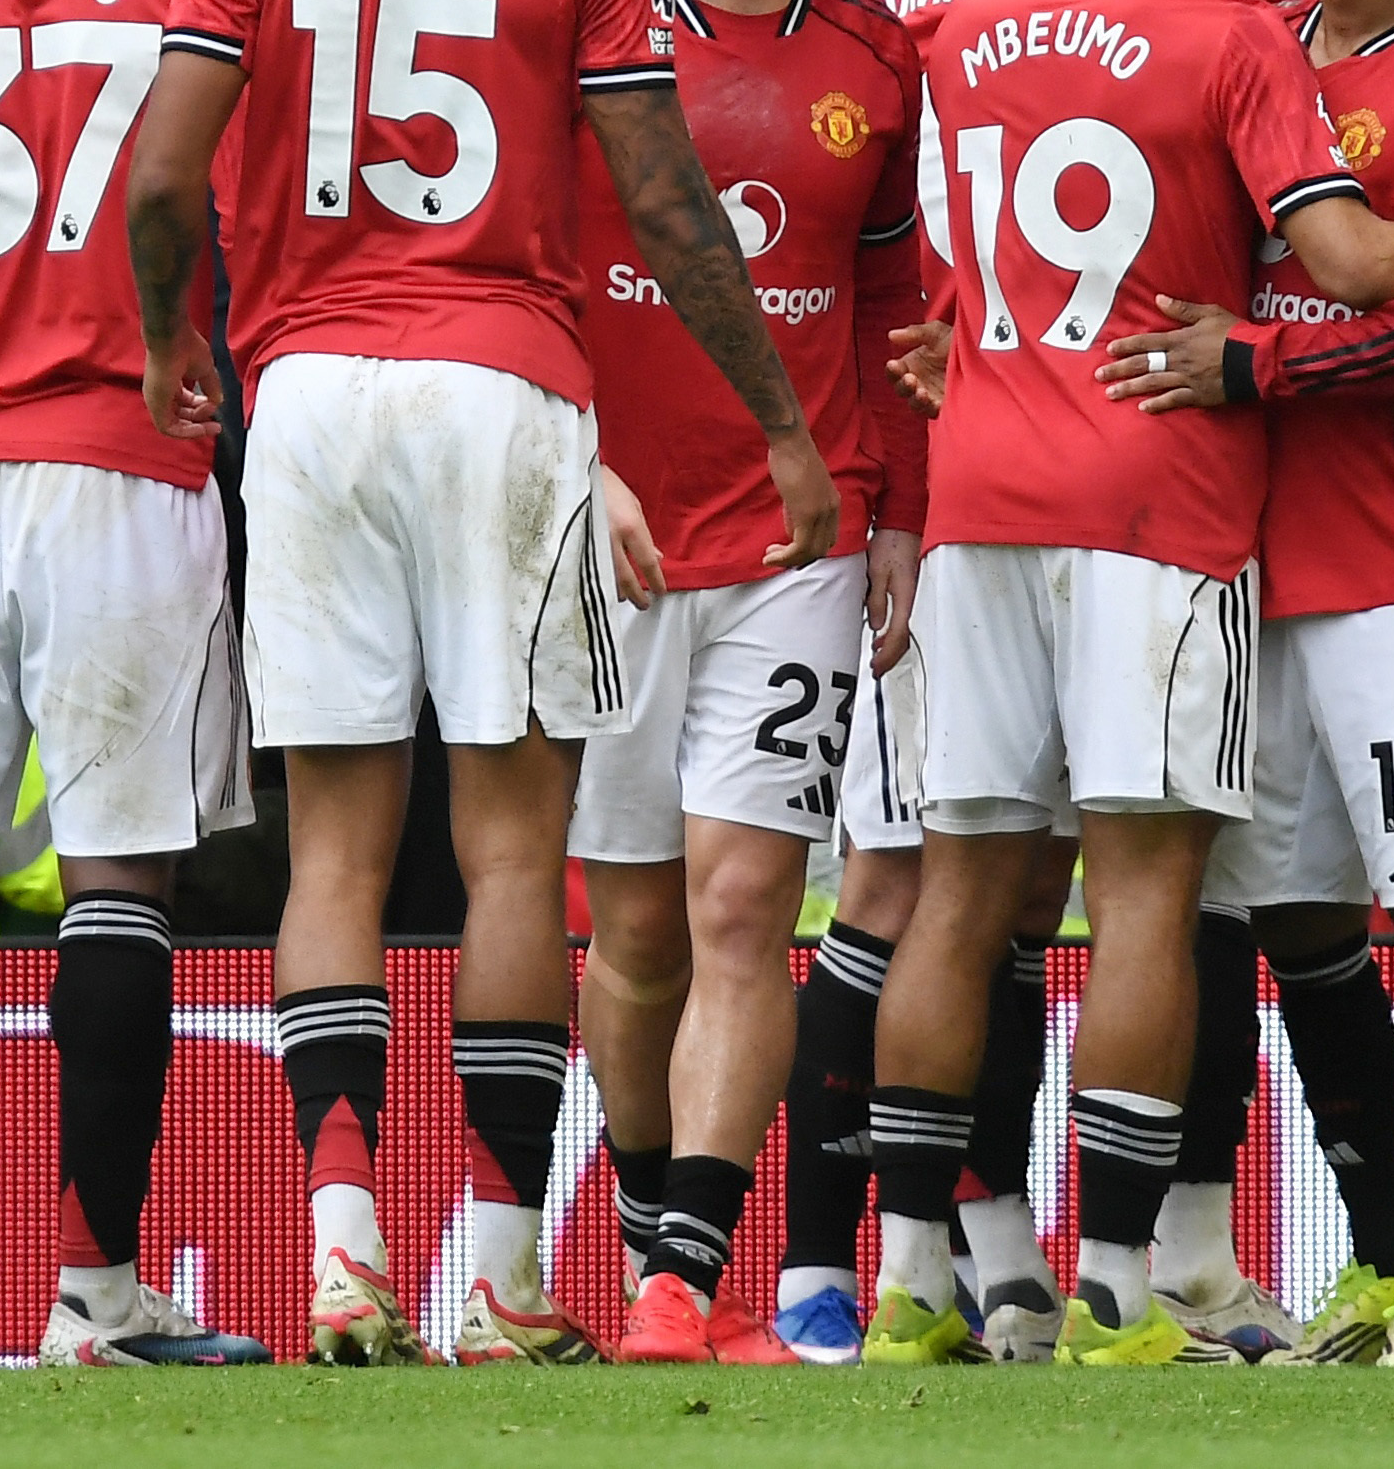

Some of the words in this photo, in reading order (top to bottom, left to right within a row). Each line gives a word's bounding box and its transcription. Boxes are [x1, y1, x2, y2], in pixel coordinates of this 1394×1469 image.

[961, 9, 1151, 89] MBEUMO
[956, 117, 1156, 352] 19
[607, 263, 836, 325] Snragon
[754, 662, 857, 767] 23
